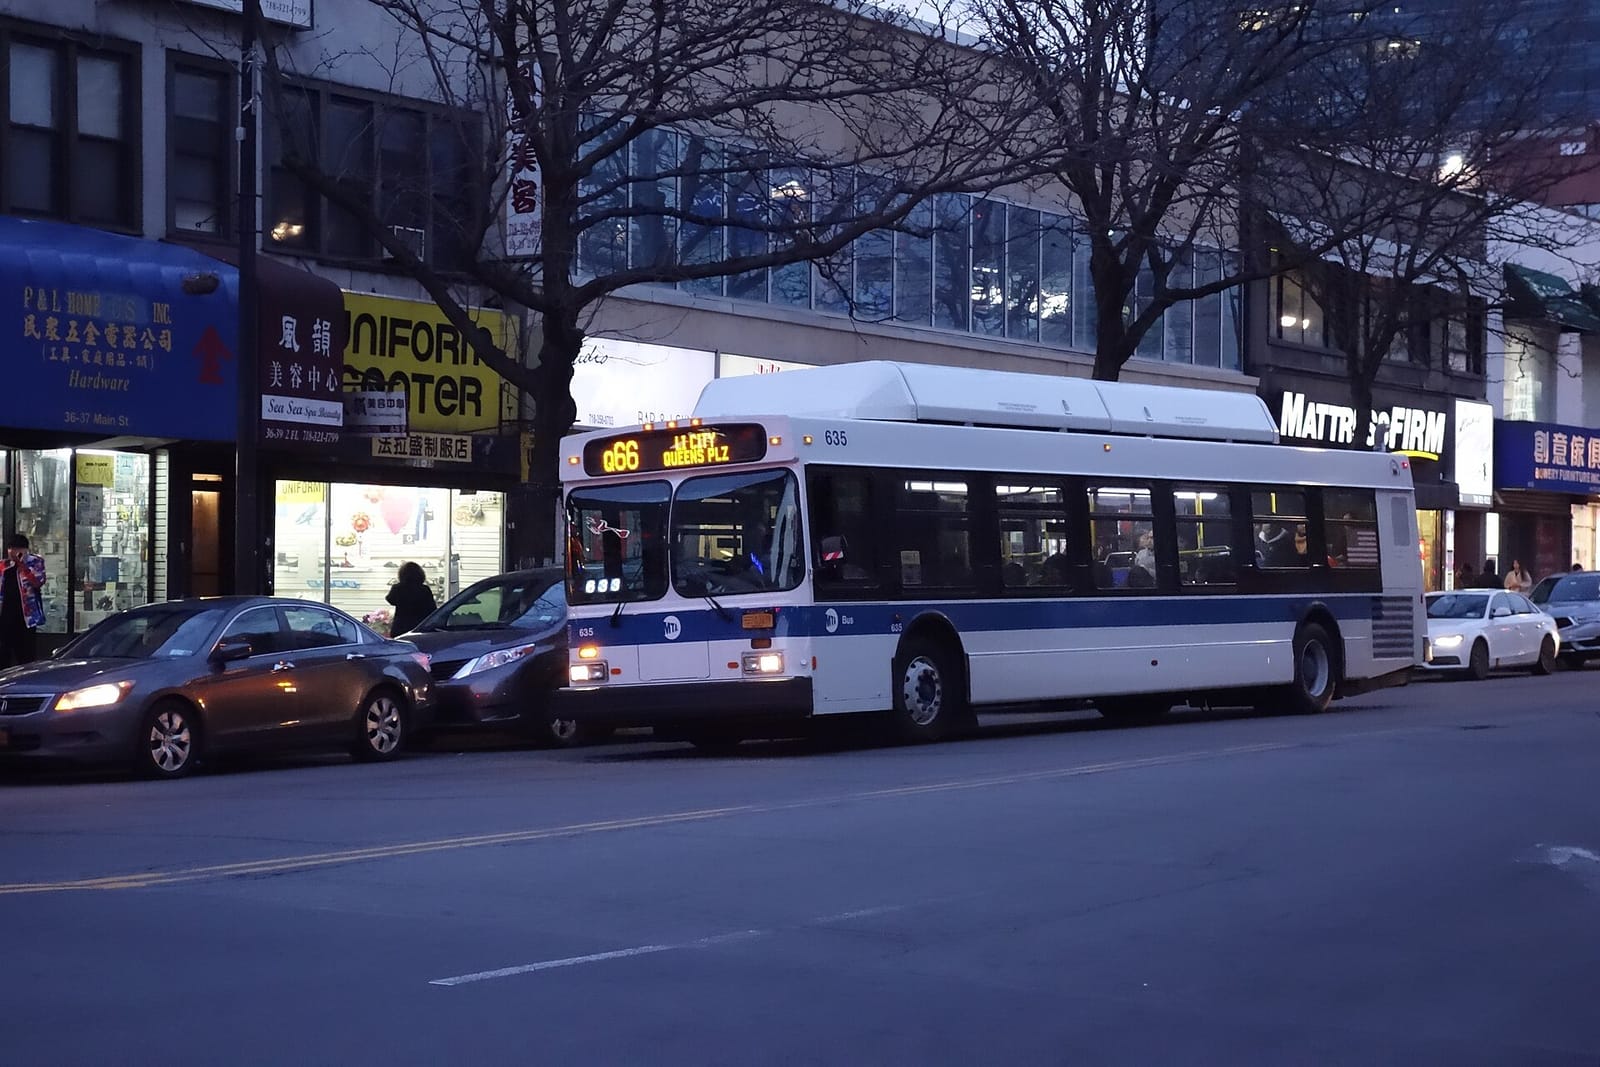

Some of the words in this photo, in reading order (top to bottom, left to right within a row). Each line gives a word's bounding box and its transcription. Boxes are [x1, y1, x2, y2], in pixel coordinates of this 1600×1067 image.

[266, 1, 306, 16] 718-321-799
[24, 286, 33, 308] P
[37, 288, 47, 311] &
[52, 290, 60, 312] L
[68, 369, 130, 391] Hardware
[270, 360, 338, 392] 美容中心
[64, 411, 90, 423] 36-37
[93, 413, 116, 425] Main
[118, 416, 129, 426] St
[267, 399, 284, 414] Sea
[286, 400, 302, 416] Sea
[304, 406, 317, 419] Spa
[378, 436, 468, 459] 法拉盛制服店
[674, 435, 687, 450] LI
[689, 432, 717, 449] CITY
[825, 430, 847, 446] 635
[603, 441, 639, 472] Q66
[663, 448, 706, 467] QUEENS
[708, 446, 729, 463] PLZ
[283, 482, 321, 495] UNIFORM
[664, 618, 680, 638] MTA
[842, 616, 854, 624] Bus
[891, 623, 902, 632] 635
[580, 628, 593, 637] 635
